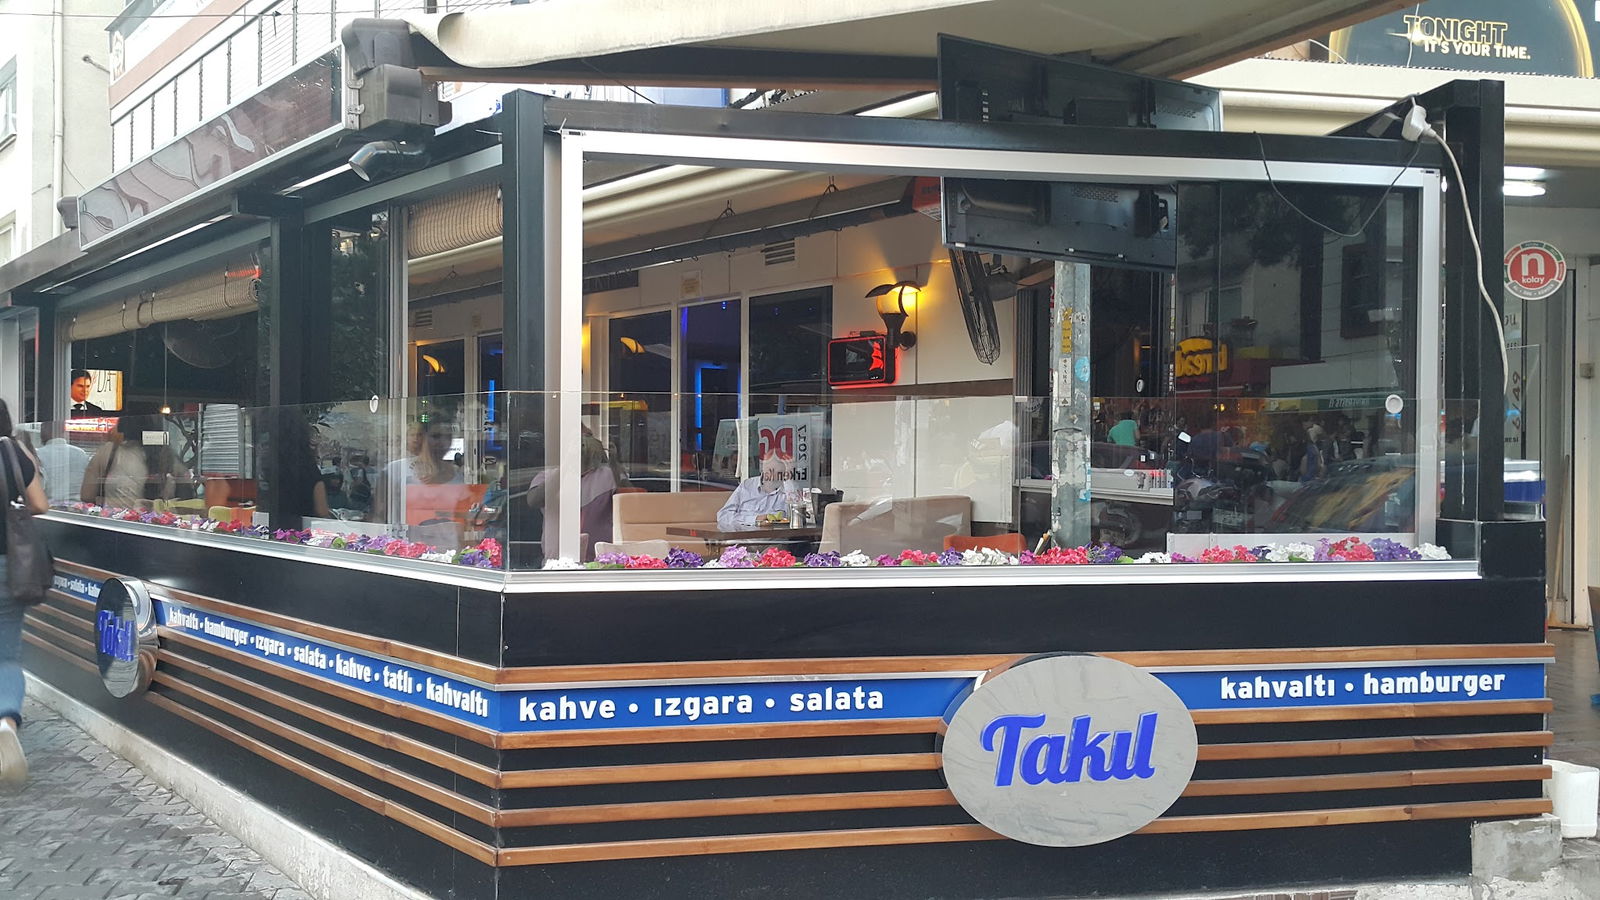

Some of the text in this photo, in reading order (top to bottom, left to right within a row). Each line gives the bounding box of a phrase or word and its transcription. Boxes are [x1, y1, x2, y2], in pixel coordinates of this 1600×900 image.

[1403, 15, 1508, 45] TONIGHT
[1424, 40, 1531, 60] IT'S YOUR TIME.
[1522, 276, 1545, 285] kolay
[204, 617, 250, 646] hamburger
[255, 635, 285, 656] ızgara
[293, 645, 327, 670] salata
[336, 653, 372, 682] kahve
[383, 666, 413, 694] tatlı
[426, 677, 488, 717] kahvaltı
[1220, 671, 1506, 700] kahvaltı hamburger
[519, 685, 884, 722] kahve ızgara salata
[979, 711, 1159, 787] Takıl
